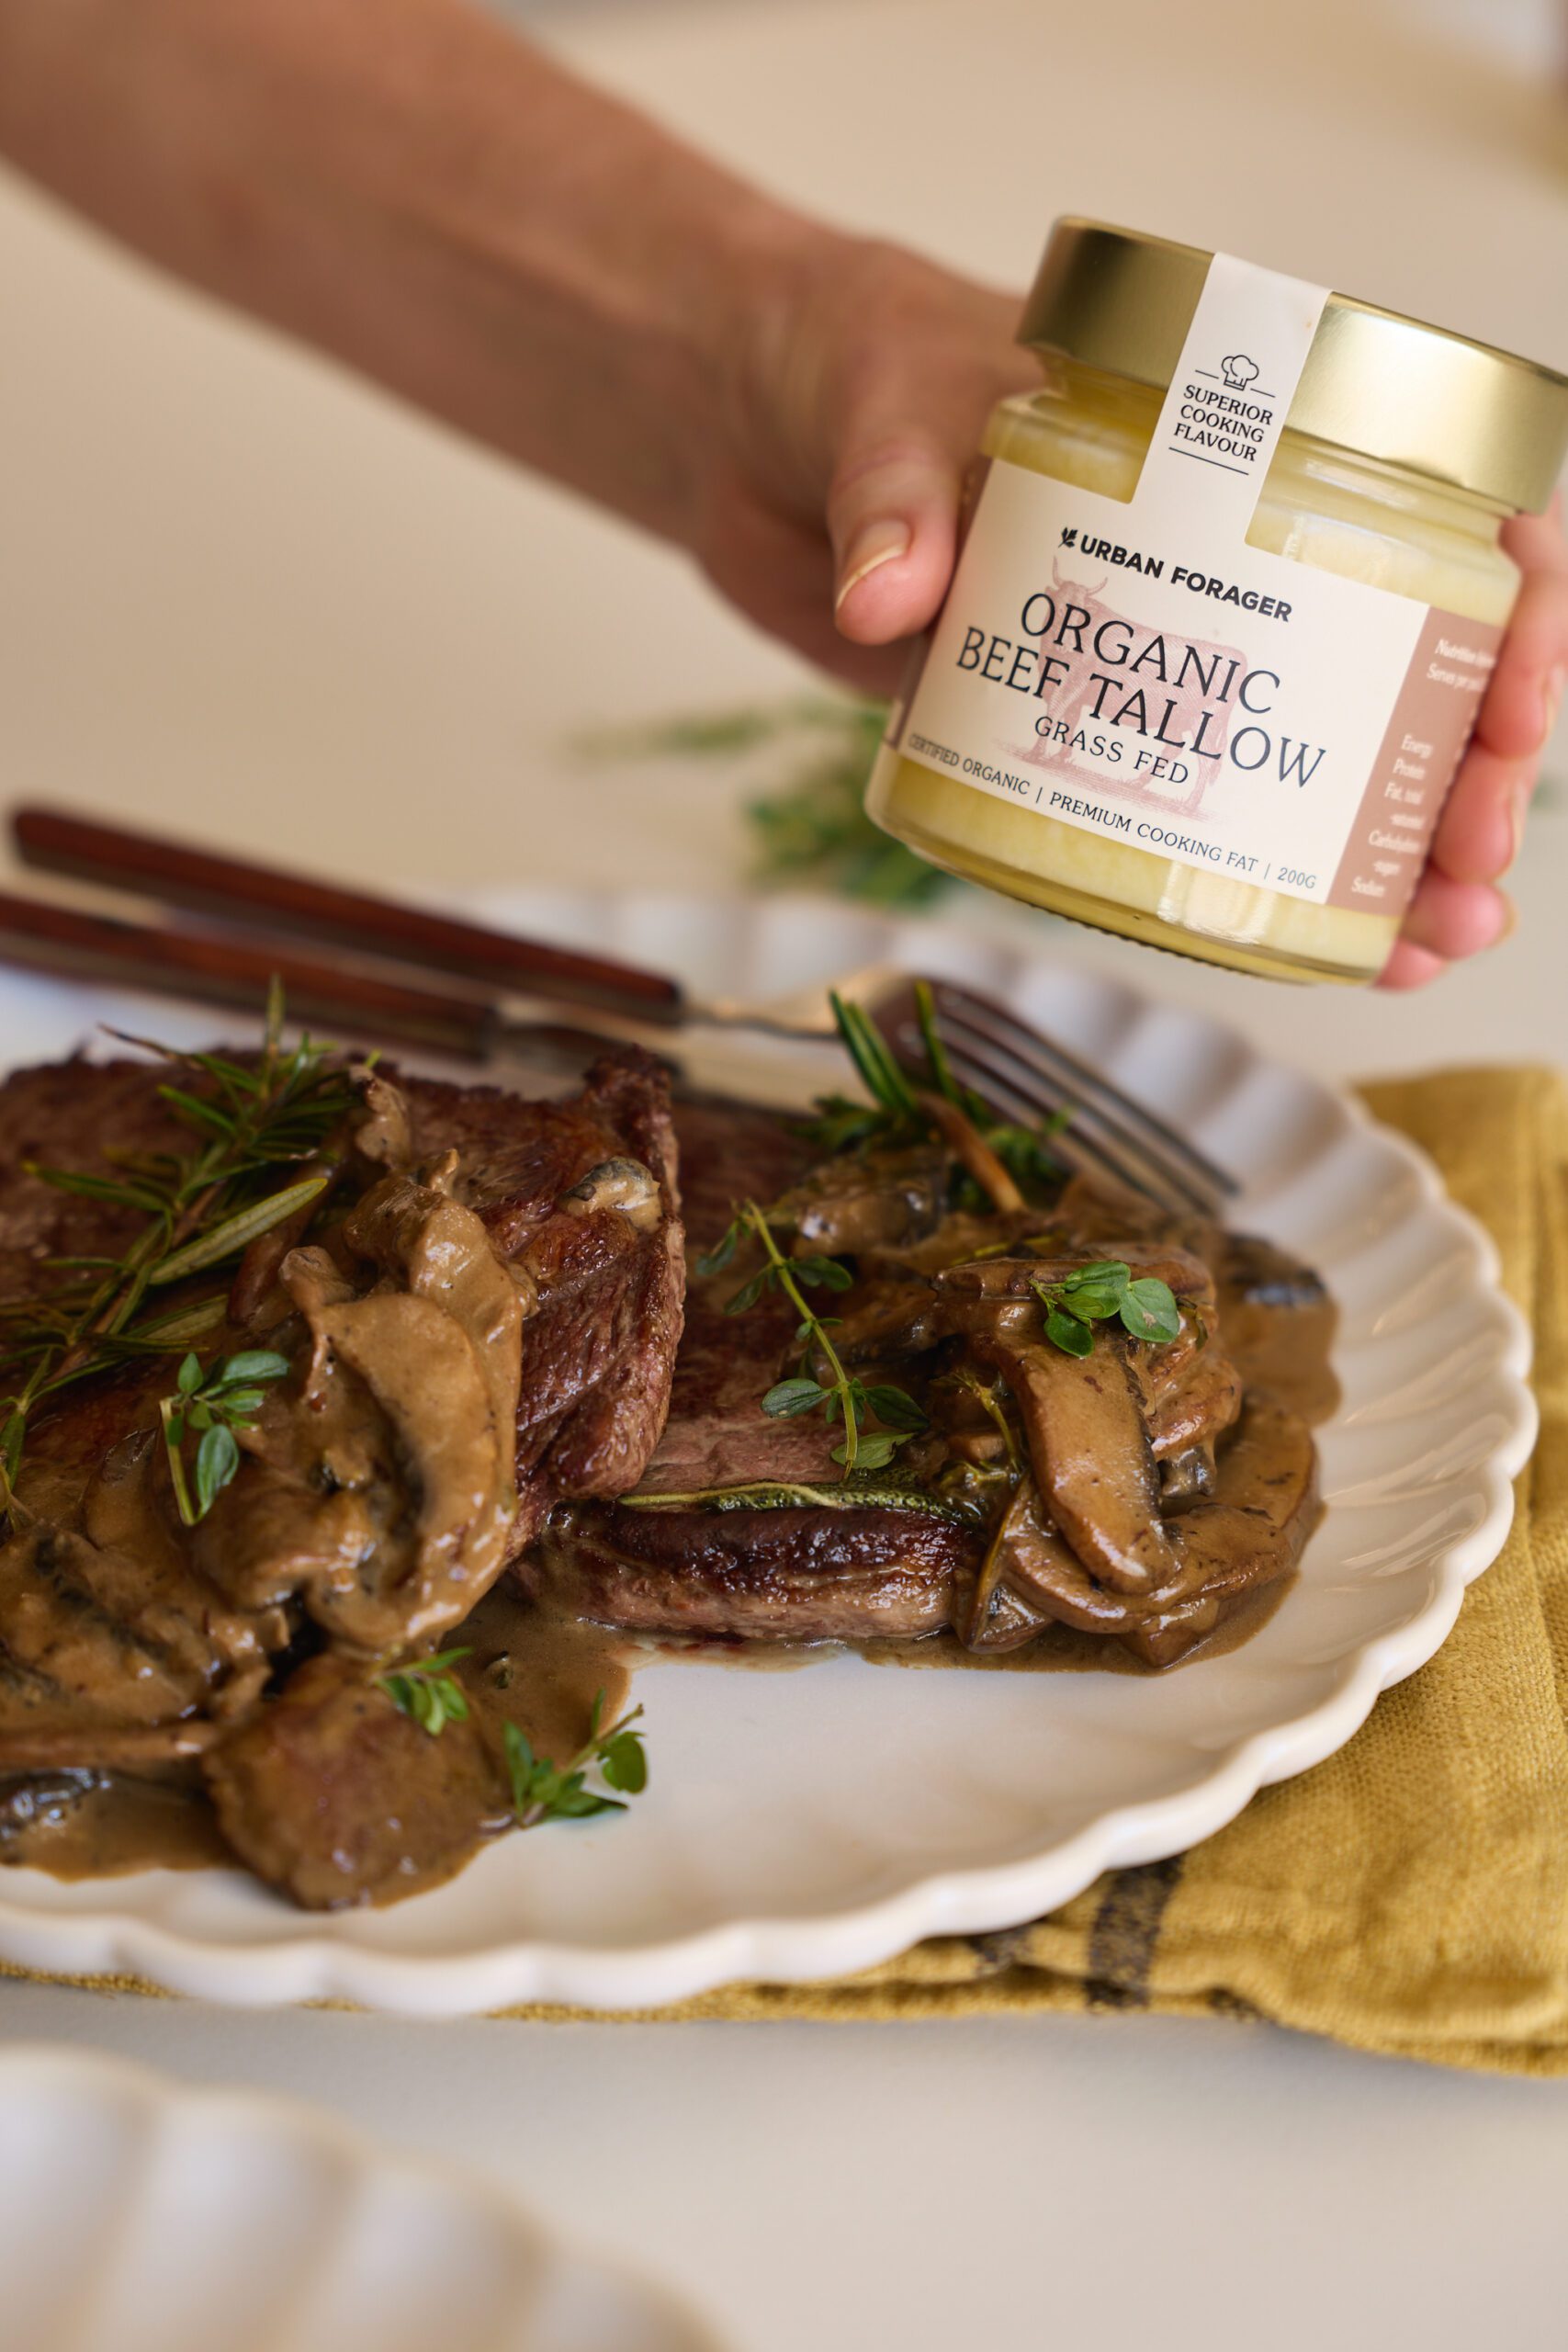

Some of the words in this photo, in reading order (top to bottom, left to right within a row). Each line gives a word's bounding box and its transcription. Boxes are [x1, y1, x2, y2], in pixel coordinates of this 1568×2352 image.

[1174, 423, 1257, 461] FLAVOUR
[1180, 404, 1265, 443] COOKING
[1183, 384, 1273, 425] SUPERIOR
[1080, 535, 1164, 578] URBAN
[1170, 566, 1292, 622] FORAGER
[1021, 593, 1280, 714] ORGANIC
[956, 627, 1070, 698] BEEF
[1089, 673, 1326, 788] TALLOW
[1034, 716, 1123, 763] GRASS
[1134, 750, 1189, 786] FED
[908, 733, 960, 766] CERTIFIED
[963, 758, 1031, 795] ORGANIC
[1049, 792, 1132, 832] PREMIUM
[1136, 823, 1222, 861] COOKING
[1226, 852, 1258, 873] FAT
[1277, 866, 1316, 889] 200G
